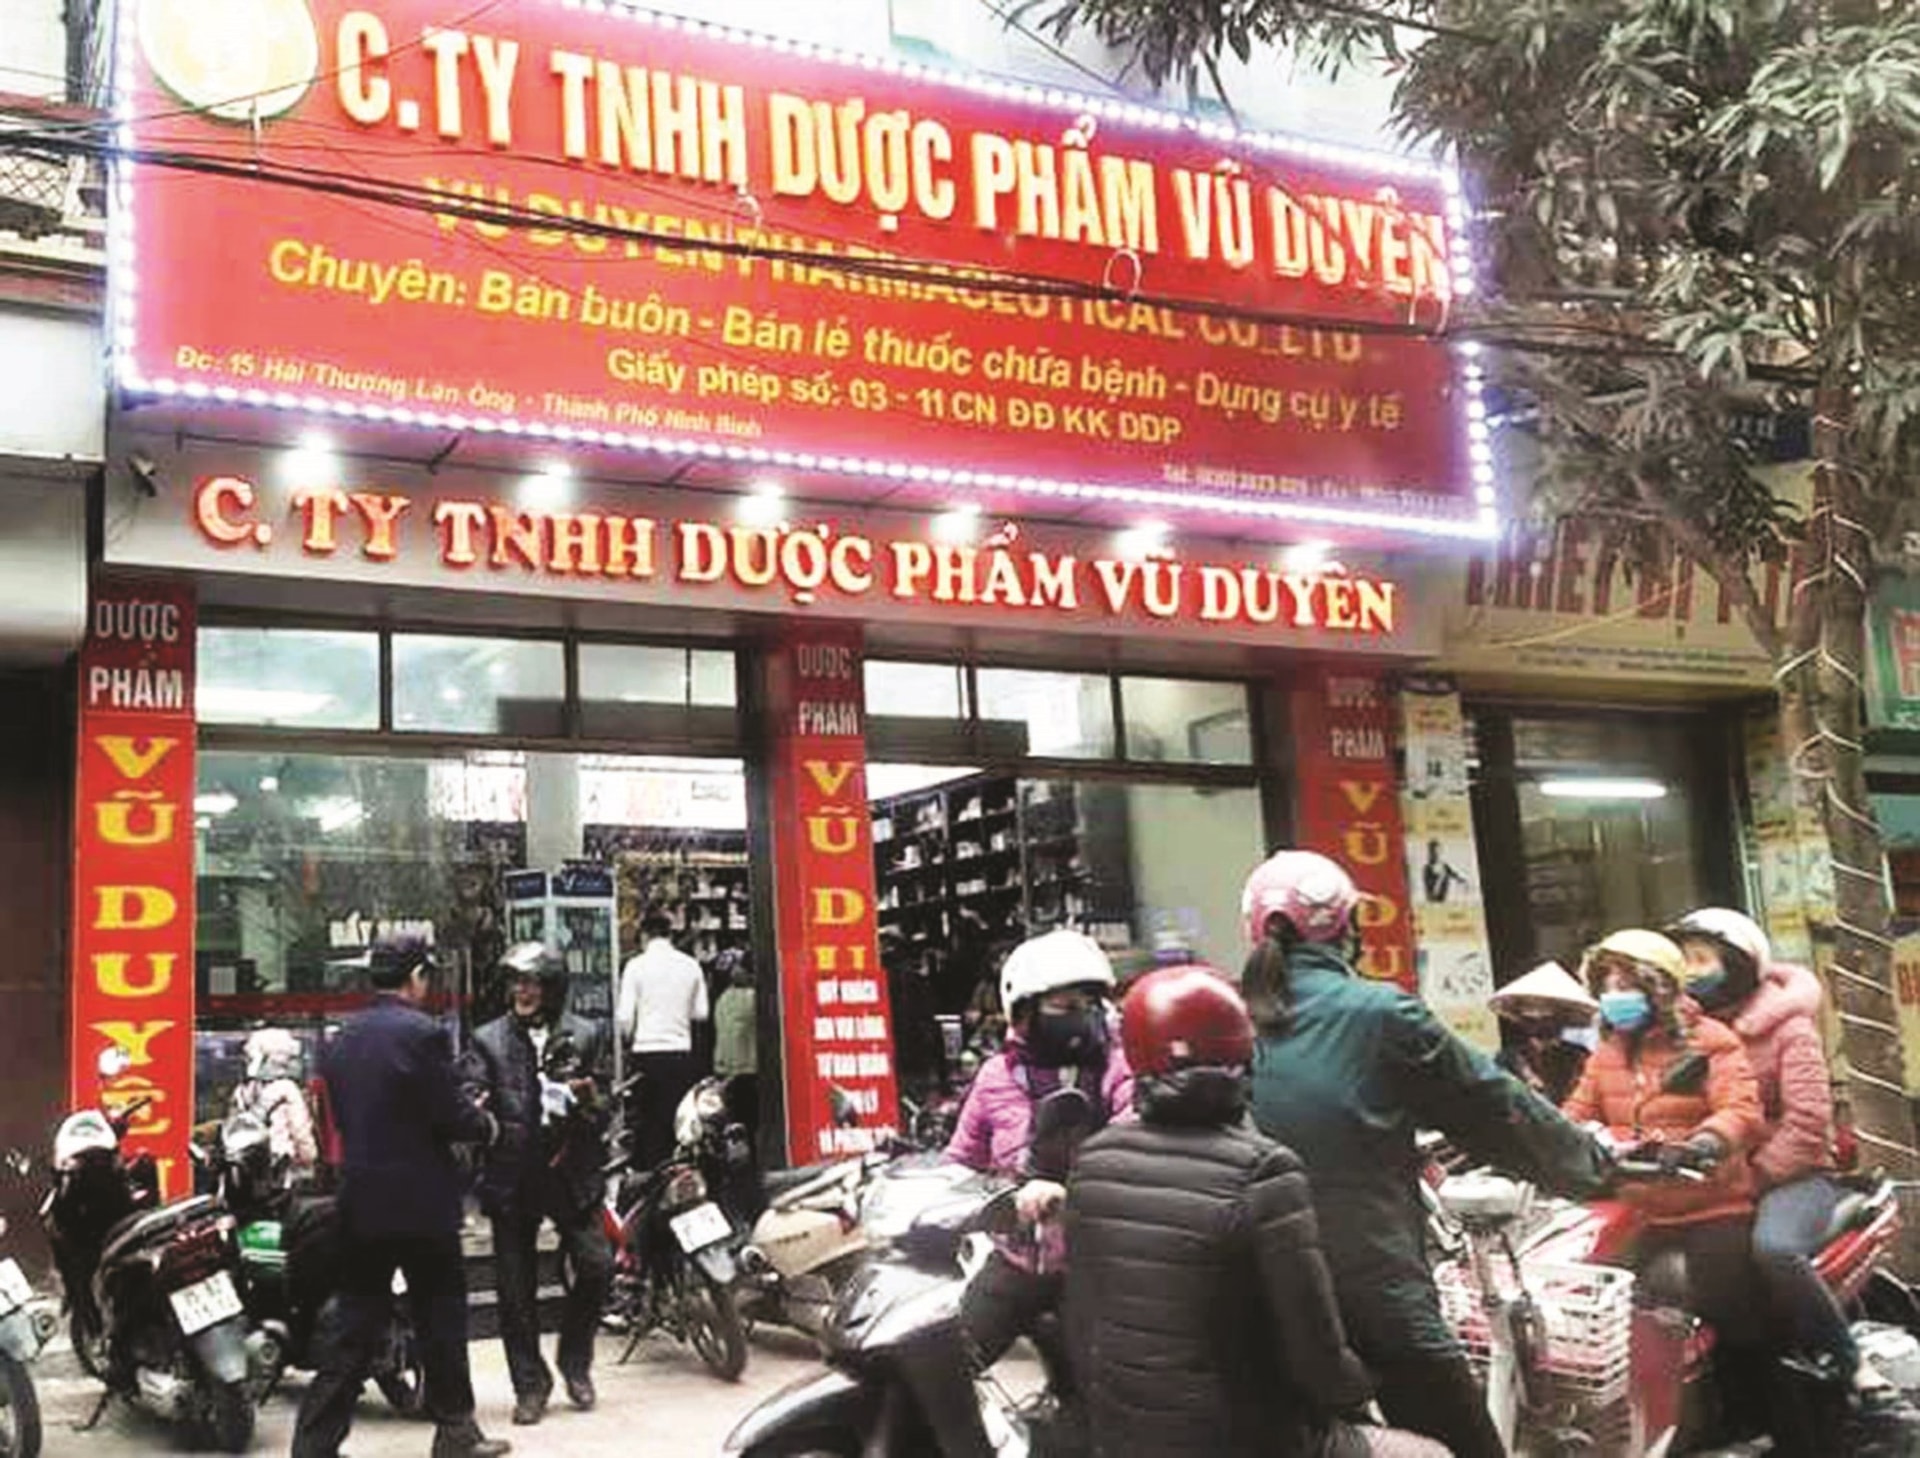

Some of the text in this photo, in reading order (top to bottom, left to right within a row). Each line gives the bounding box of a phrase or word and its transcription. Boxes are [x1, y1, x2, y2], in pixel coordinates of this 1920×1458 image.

[336, 11, 1455, 297] C.TY TNHH DƯỢC PHẨM VŨ DUYÊN
[269, 239, 468, 308] Chuyên:
[477, 269, 571, 321] Bán
[580, 283, 691, 336] buôn
[722, 305, 803, 354] Bán
[863, 327, 973, 377] thuốc
[982, 345, 1073, 391] chữa
[1080, 355, 1168, 403] bệnh
[1195, 372, 1282, 424] Dụng
[1288, 389, 1331, 430] cụ
[1338, 397, 1359, 431] y
[1369, 390, 1402, 430] tế
[607, 348, 686, 394] Giấy
[697, 363, 782, 404] phép
[790, 371, 841, 406] số:
[850, 378, 888, 411] 03
[951, 391, 997, 424] CN
[1062, 407, 1112, 438] KK
[197, 476, 272, 546] C.
[295, 488, 410, 560] TY
[434, 502, 655, 578] TNHH
[678, 519, 873, 603] DƯỢC
[890, 523, 1078, 609] PHẨM
[1093, 552, 1182, 618] VŨ
[1199, 560, 1396, 633] DUYÊN
[89, 885, 178, 1205] DUYÊ
